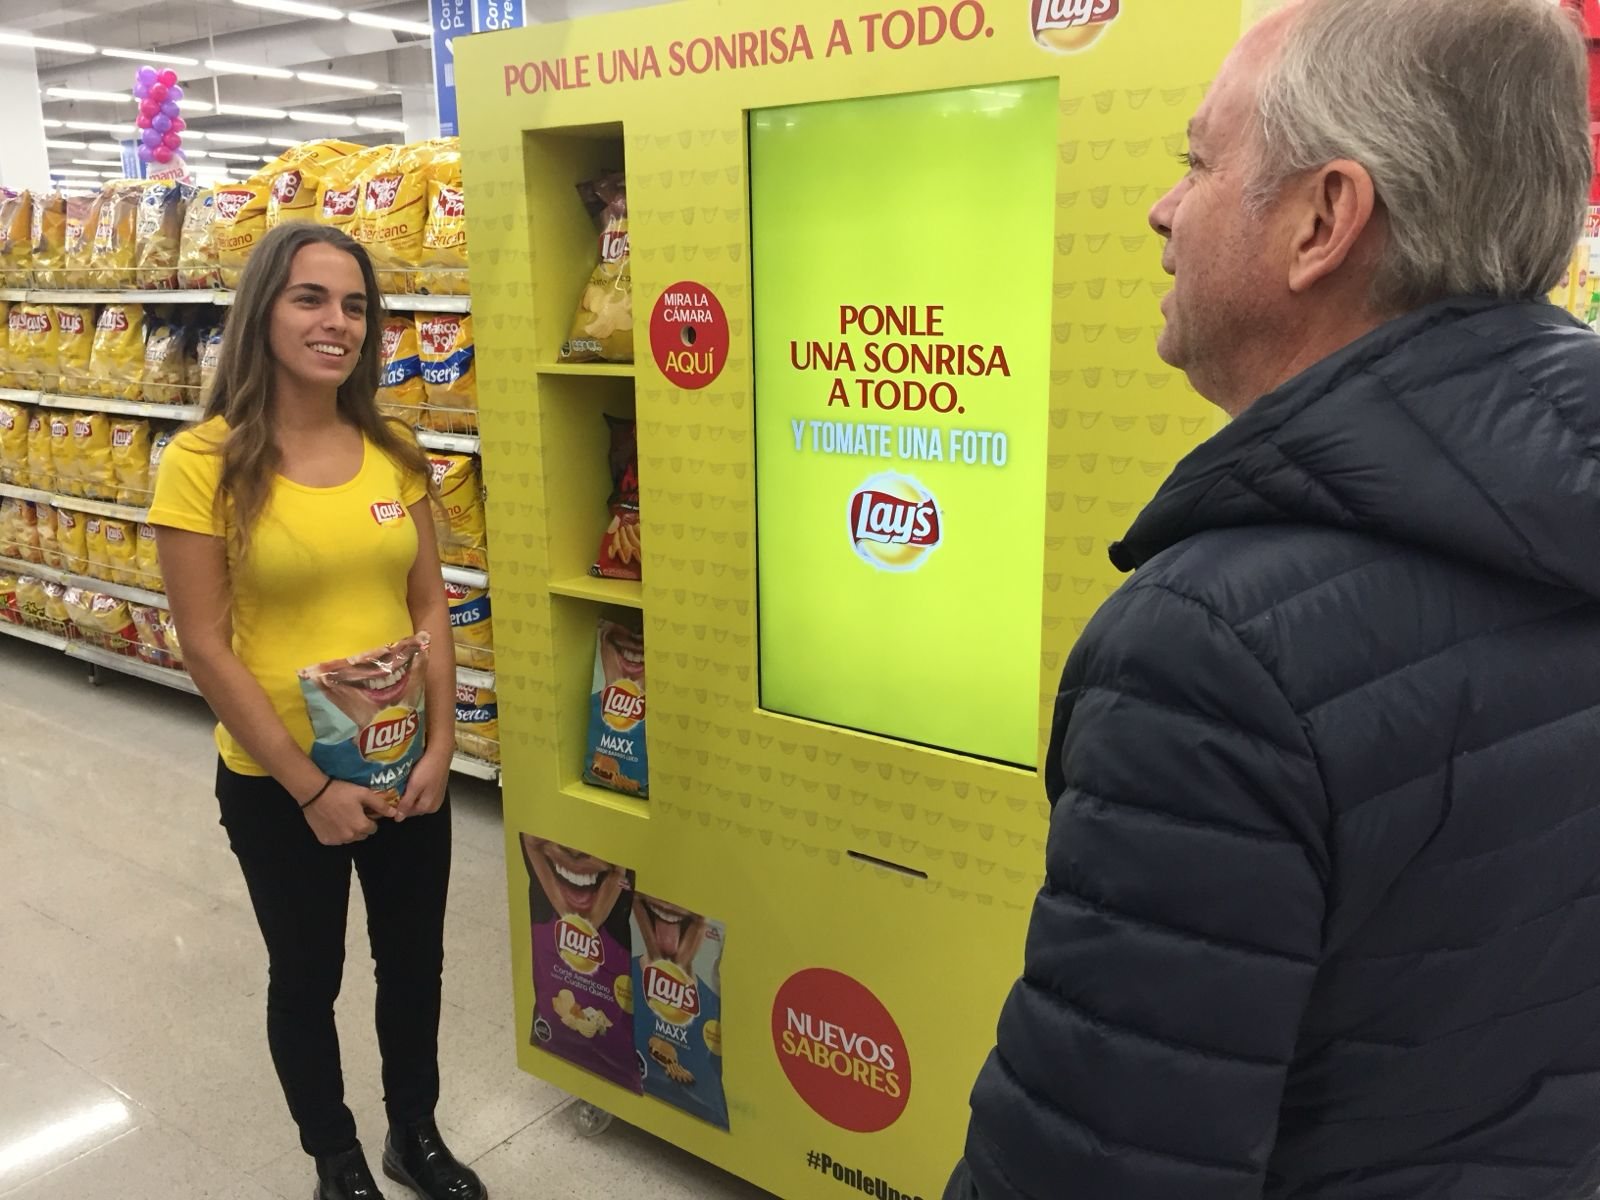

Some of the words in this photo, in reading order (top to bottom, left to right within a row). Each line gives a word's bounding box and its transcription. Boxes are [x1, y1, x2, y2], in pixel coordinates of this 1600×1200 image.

[504, 55, 591, 96] PONLE
[597, 45, 662, 84] UNA
[668, 25, 814, 76] SONRISA
[825, 19, 853, 58] A
[859, 0, 994, 53] TODO.
[663, 306, 714, 323] CÁMARA
[664, 293, 692, 306] MIRA
[694, 293, 709, 307] LA
[840, 304, 944, 336] PONLE
[665, 347, 714, 375] AQUÍ
[790, 341, 856, 372] UNA
[864, 342, 1011, 376] SONRISA
[827, 378, 850, 407] A
[855, 379, 965, 414] TODO.
[791, 419, 805, 451] Y
[810, 421, 892, 457] TOMATE
[899, 426, 943, 462] UNA
[950, 429, 1007, 466] FOTO
[856, 492, 934, 544] Lay's
[604, 688, 645, 718] Lay's
[365, 712, 416, 755] Lay's
[600, 733, 634, 755] MAXX
[560, 922, 600, 958] Lay's
[647, 968, 696, 1009] Lay's
[655, 1019, 688, 1044] MAXX
[787, 1007, 895, 1070] NUEVOS
[782, 1030, 900, 1098] SABORES
